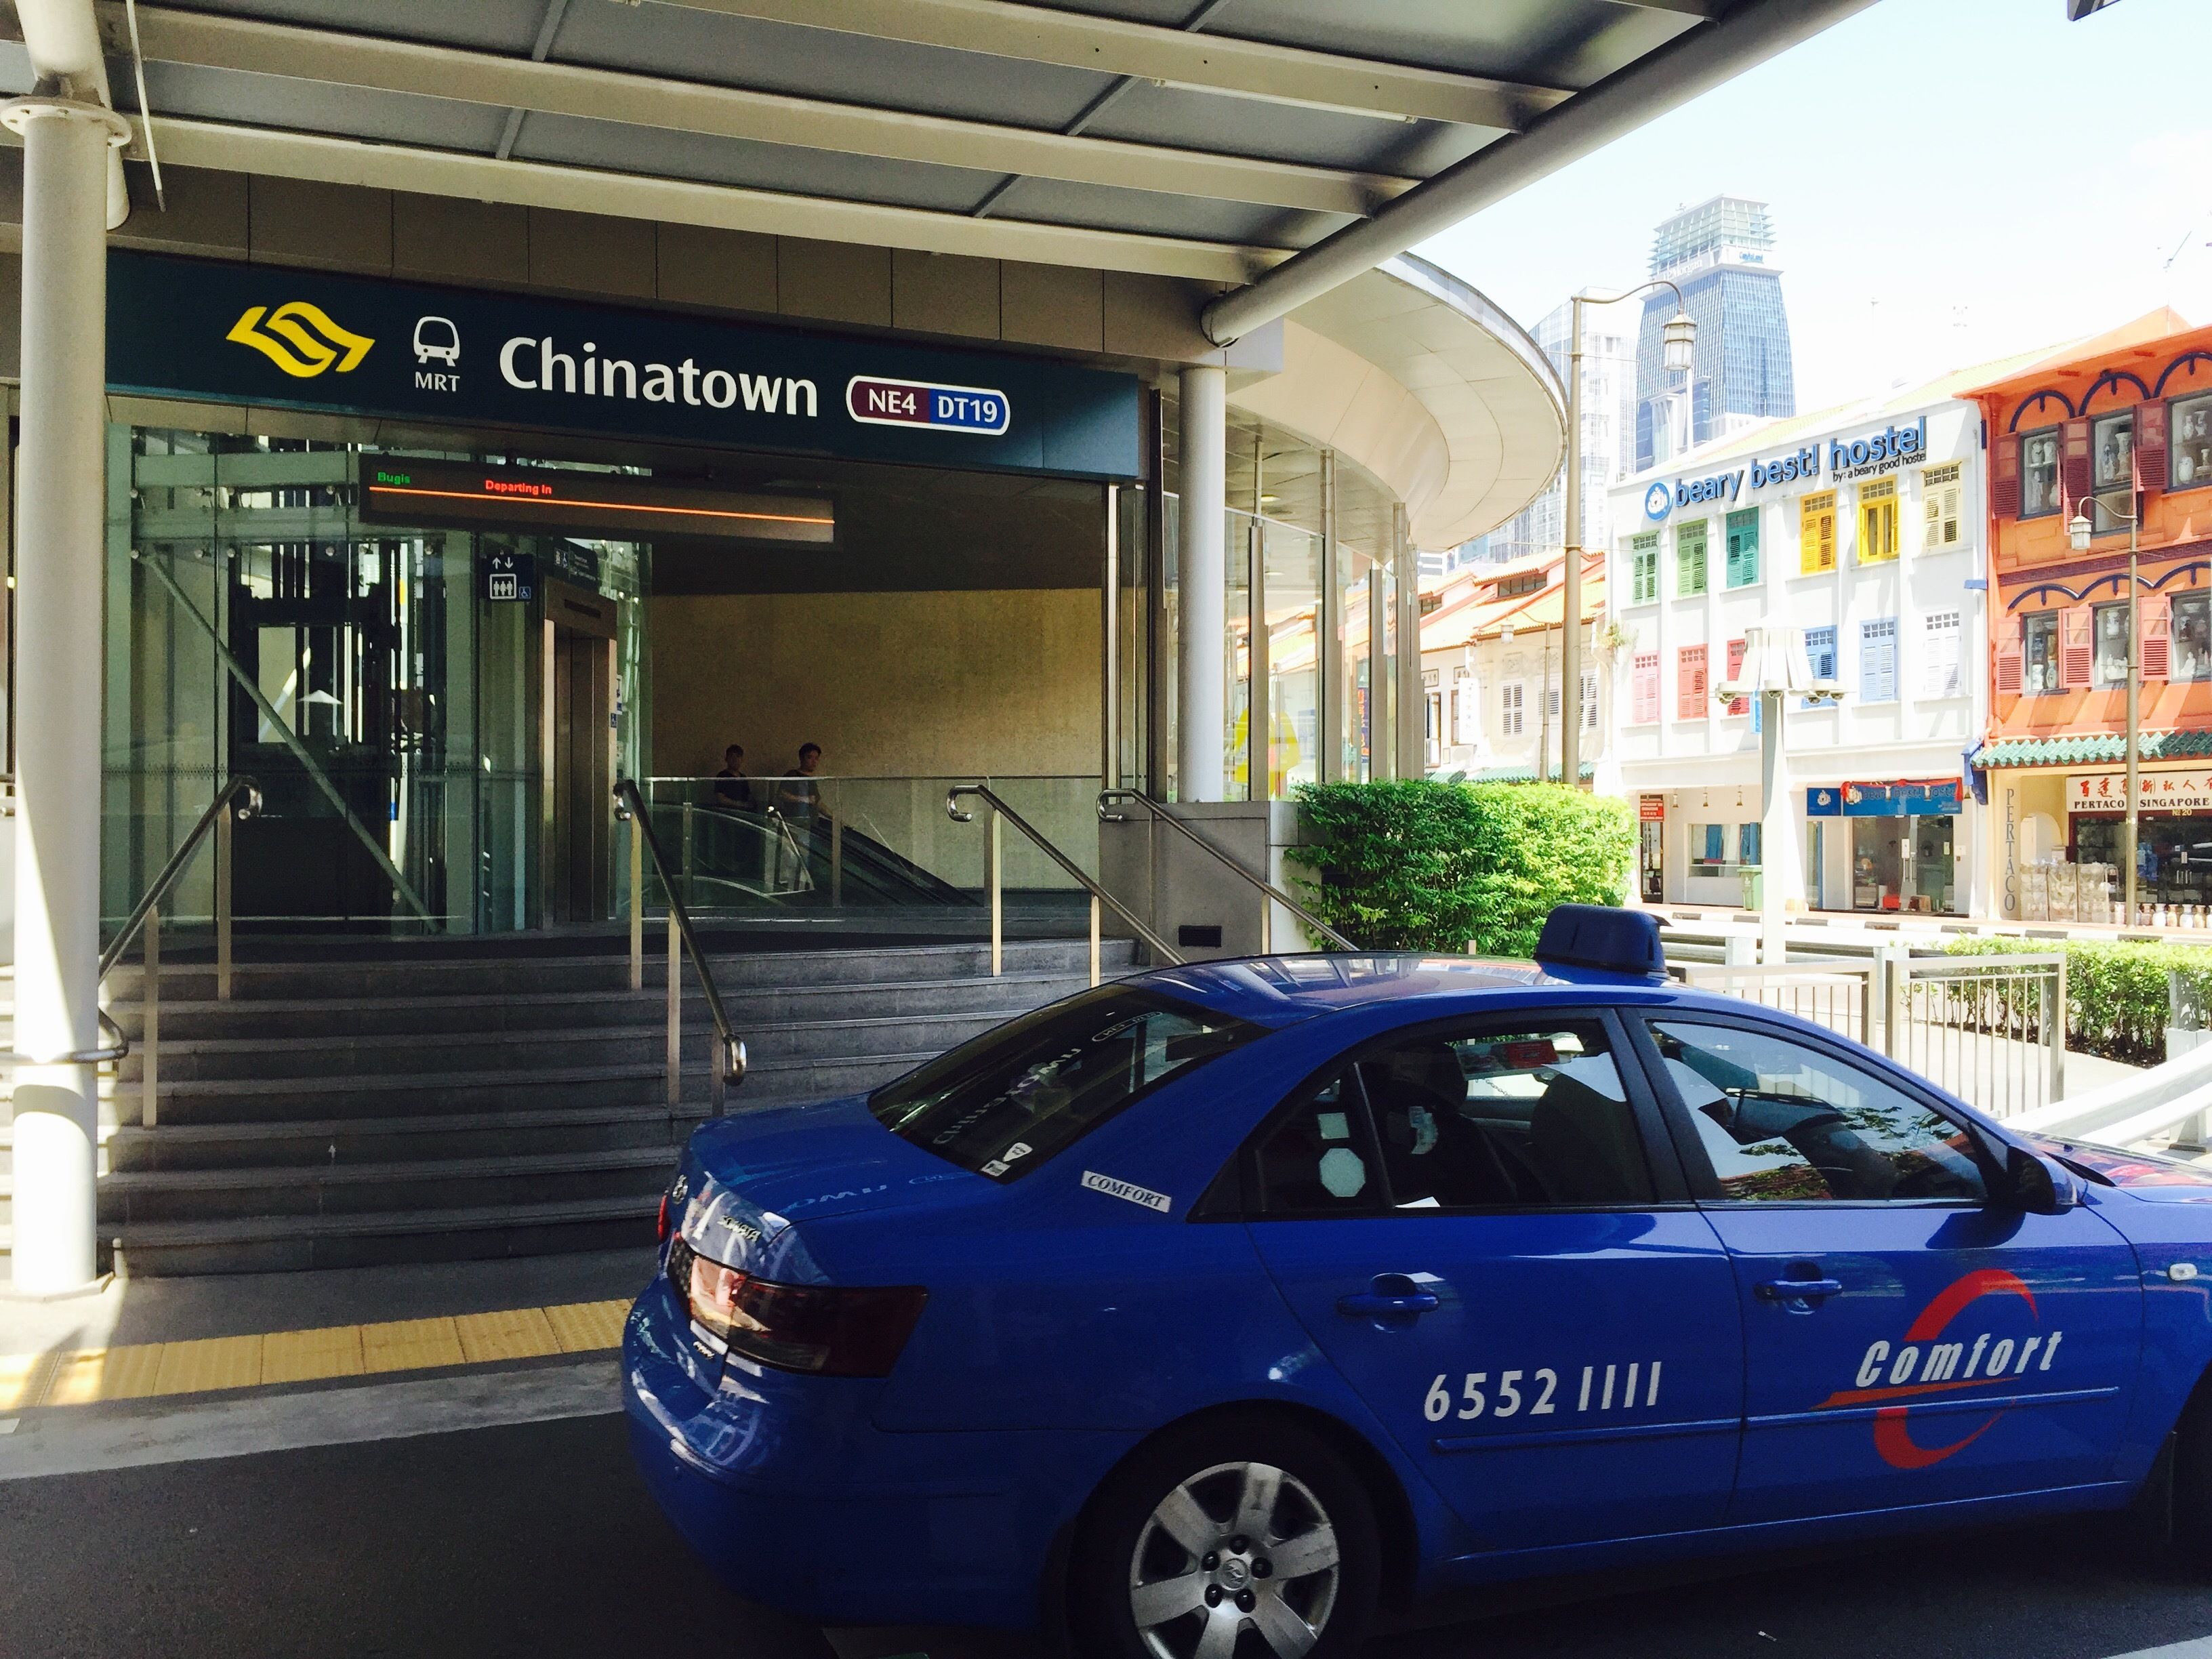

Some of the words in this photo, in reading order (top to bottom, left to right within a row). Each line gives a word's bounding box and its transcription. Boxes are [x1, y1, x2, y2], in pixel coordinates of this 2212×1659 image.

[415, 371, 460, 392] MRT
[499, 336, 818, 417] Chinatown
[868, 388, 916, 416] NE4
[939, 395, 998, 424] DT19
[377, 472, 411, 485] Bugis
[485, 480, 539, 495] Departing
[1675, 470, 1745, 507] beary
[1750, 444, 1820, 489] best!
[1829, 415, 1927, 470] hostel
[1848, 470, 1853, 478] a
[1854, 464, 1877, 475] beary
[1879, 457, 1900, 474] good
[2074, 800, 2125, 809] PERTACO
[2139, 798, 2209, 808] SINGAPORE
[2004, 789, 2015, 911] PERTACO
[1088, 1175, 1165, 1207] COMFORT
[1855, 1330, 2064, 1389] Comfort
[1424, 1368, 1558, 1422] 6552
[1578, 1361, 1662, 1412] 1111
